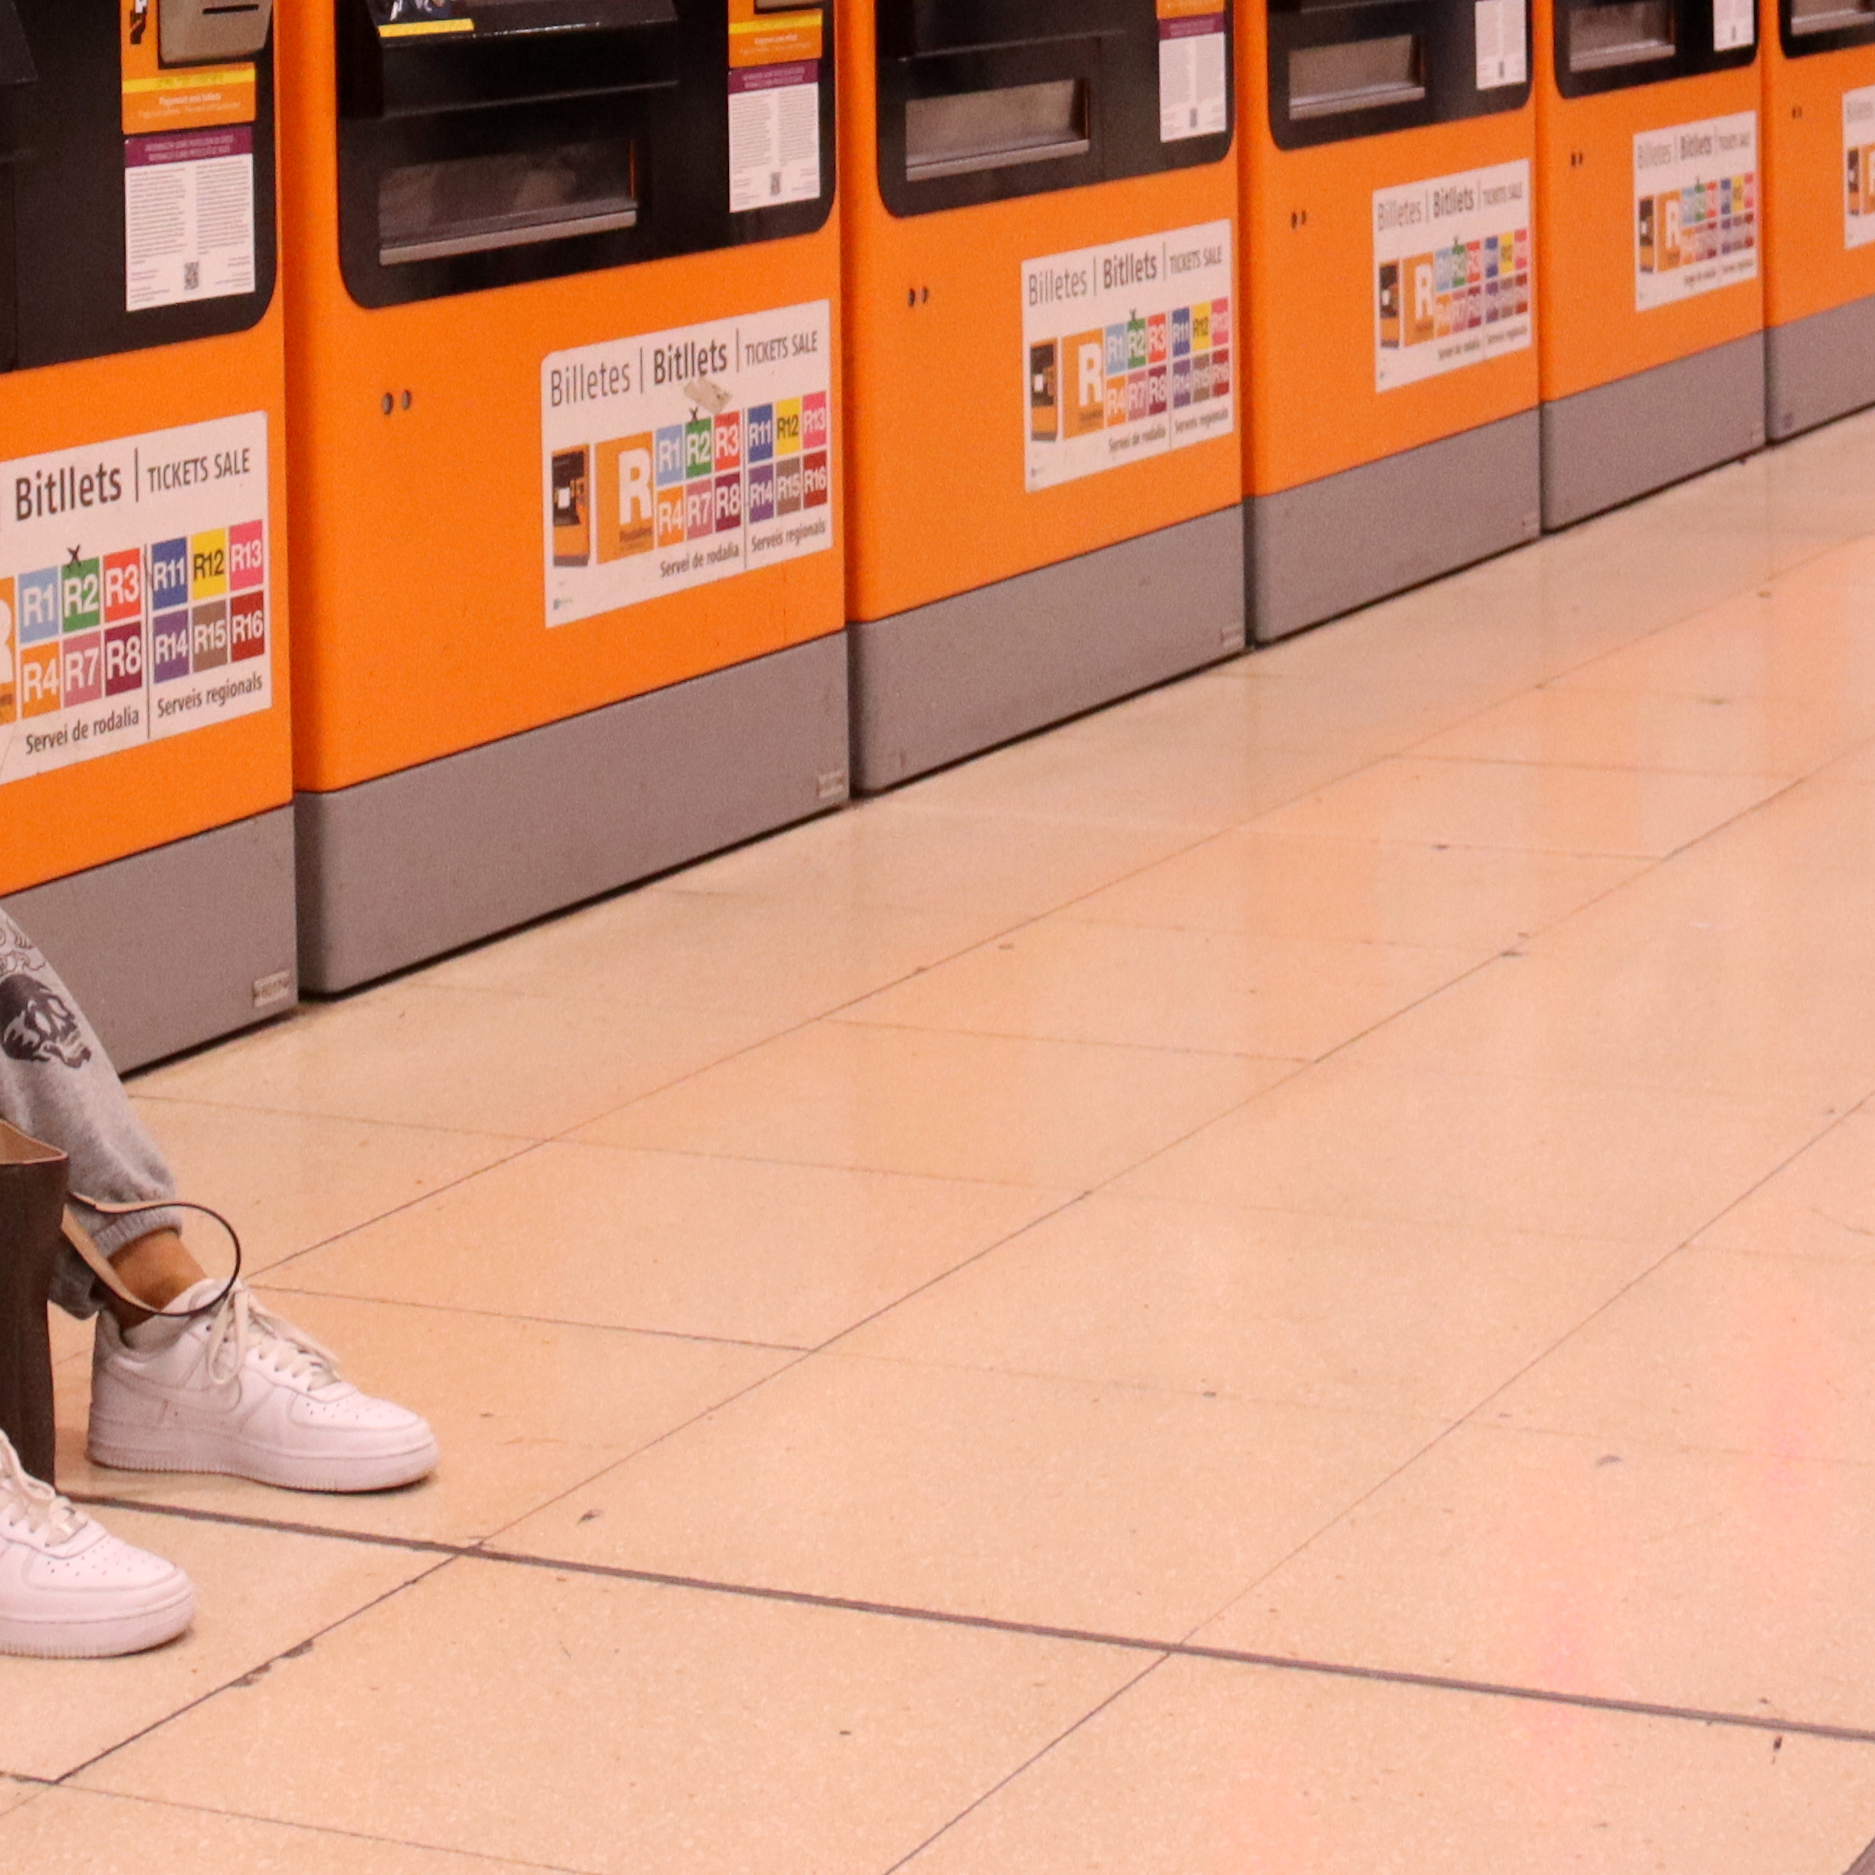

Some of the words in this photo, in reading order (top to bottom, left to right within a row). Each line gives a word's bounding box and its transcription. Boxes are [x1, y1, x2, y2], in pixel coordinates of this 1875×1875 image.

[1029, 271, 1088, 308] Billetes
[1103, 251, 1157, 290] Bitllets
[550, 361, 631, 407] Billetes
[653, 338, 727, 387] Bitllets
[745, 335, 788, 367] TICKETS
[792, 330, 818, 355] SALE
[1128, 327, 1146, 356] R2
[1078, 342, 1103, 407] R
[1128, 379, 1147, 409] R7
[658, 438, 681, 472] R1
[686, 430, 711, 464] R2
[714, 423, 740, 457] R3
[749, 421, 773, 446] R11
[777, 412, 799, 439] R12
[15, 461, 122, 523] Bitllets
[147, 458, 209, 493] TICKETS
[214, 446, 251, 479] SALE
[619, 445, 653, 526] R
[658, 501, 684, 537] R4
[687, 492, 712, 527] R7
[715, 484, 741, 518] R8
[153, 555, 186, 592] R11
[193, 546, 225, 580] R12
[230, 535, 263, 572] R13
[660, 553, 692, 578] Servei
[693, 552, 705, 569] de
[752, 530, 784, 554] Serveis
[22, 585, 55, 628] R1
[62, 573, 99, 619] R2
[104, 562, 141, 608] R3
[154, 632, 189, 668] R14
[193, 619, 227, 653] R15
[230, 608, 264, 645] R16
[22, 662, 60, 706] R4
[64, 648, 99, 694] R7
[105, 636, 142, 681] R8
[157, 690, 203, 718] Serveis
[205, 671, 263, 709] regionals
[25, 723, 68, 755] Servei
[72, 720, 88, 742] de
[92, 706, 140, 735] rodalia
